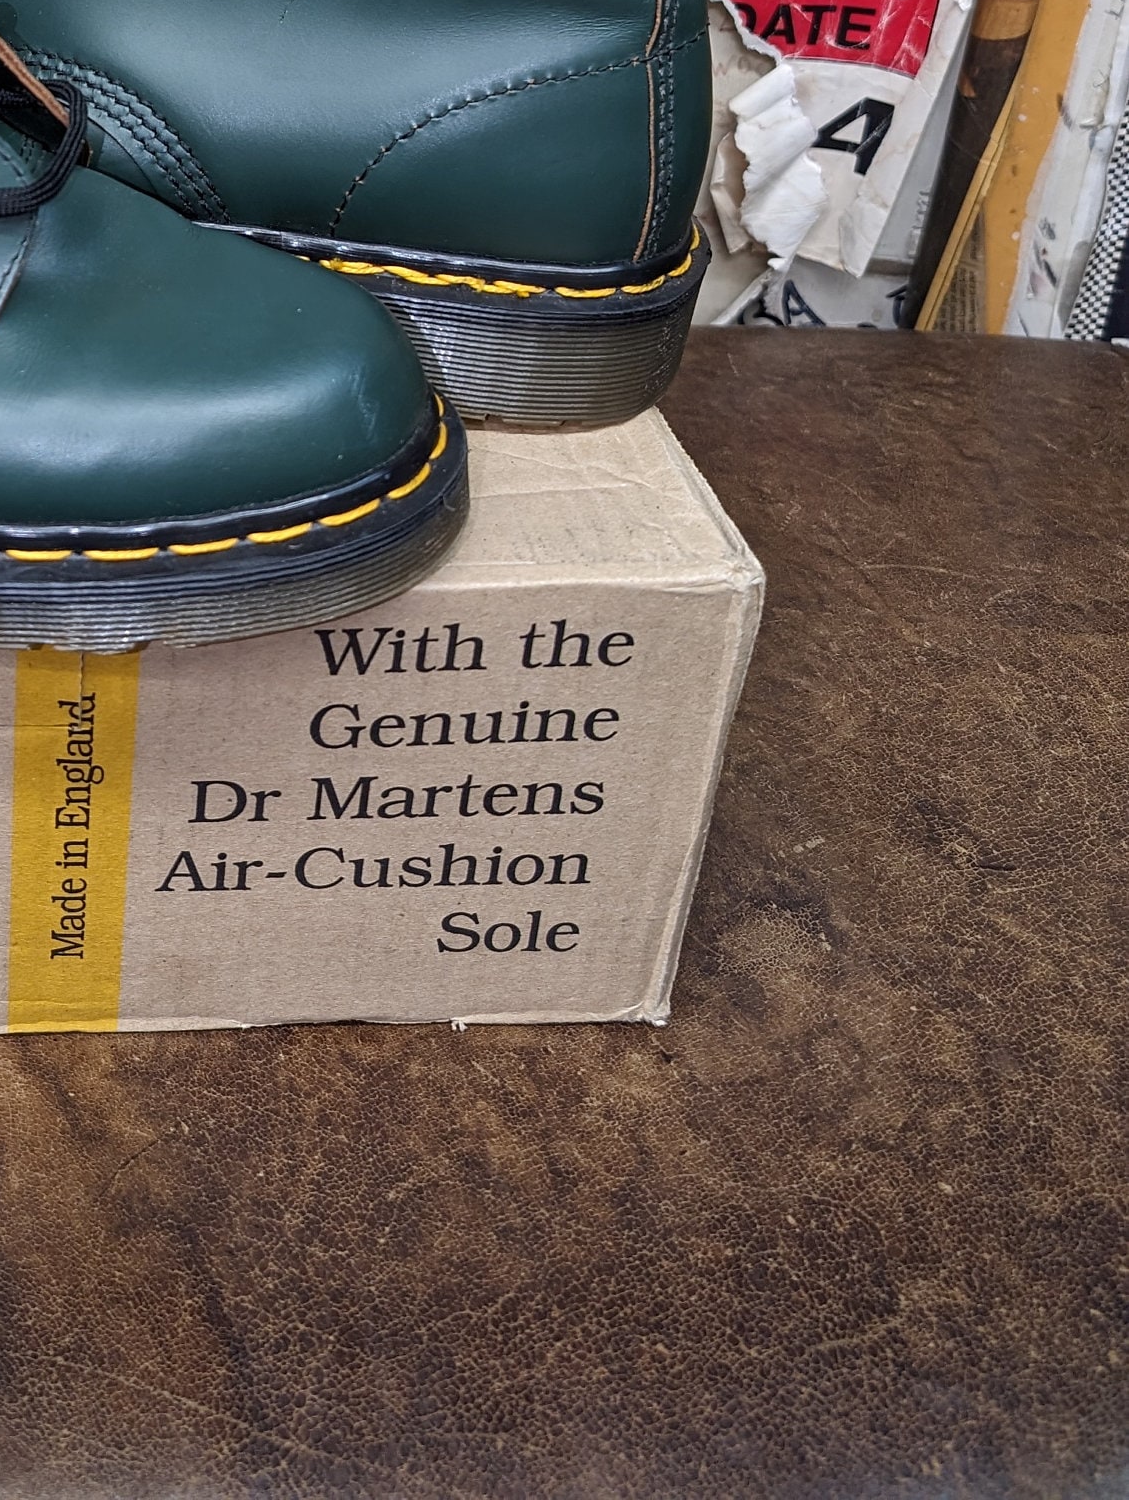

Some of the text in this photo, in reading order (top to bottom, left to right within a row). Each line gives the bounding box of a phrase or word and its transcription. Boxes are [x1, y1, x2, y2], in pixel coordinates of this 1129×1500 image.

[314, 619, 635, 676] With the
[308, 700, 620, 749] Genuine
[188, 774, 605, 823] Dr Martens
[50, 692, 105, 960] Made in England
[154, 843, 591, 893] Air-Cushion
[436, 910, 581, 953] Sole
